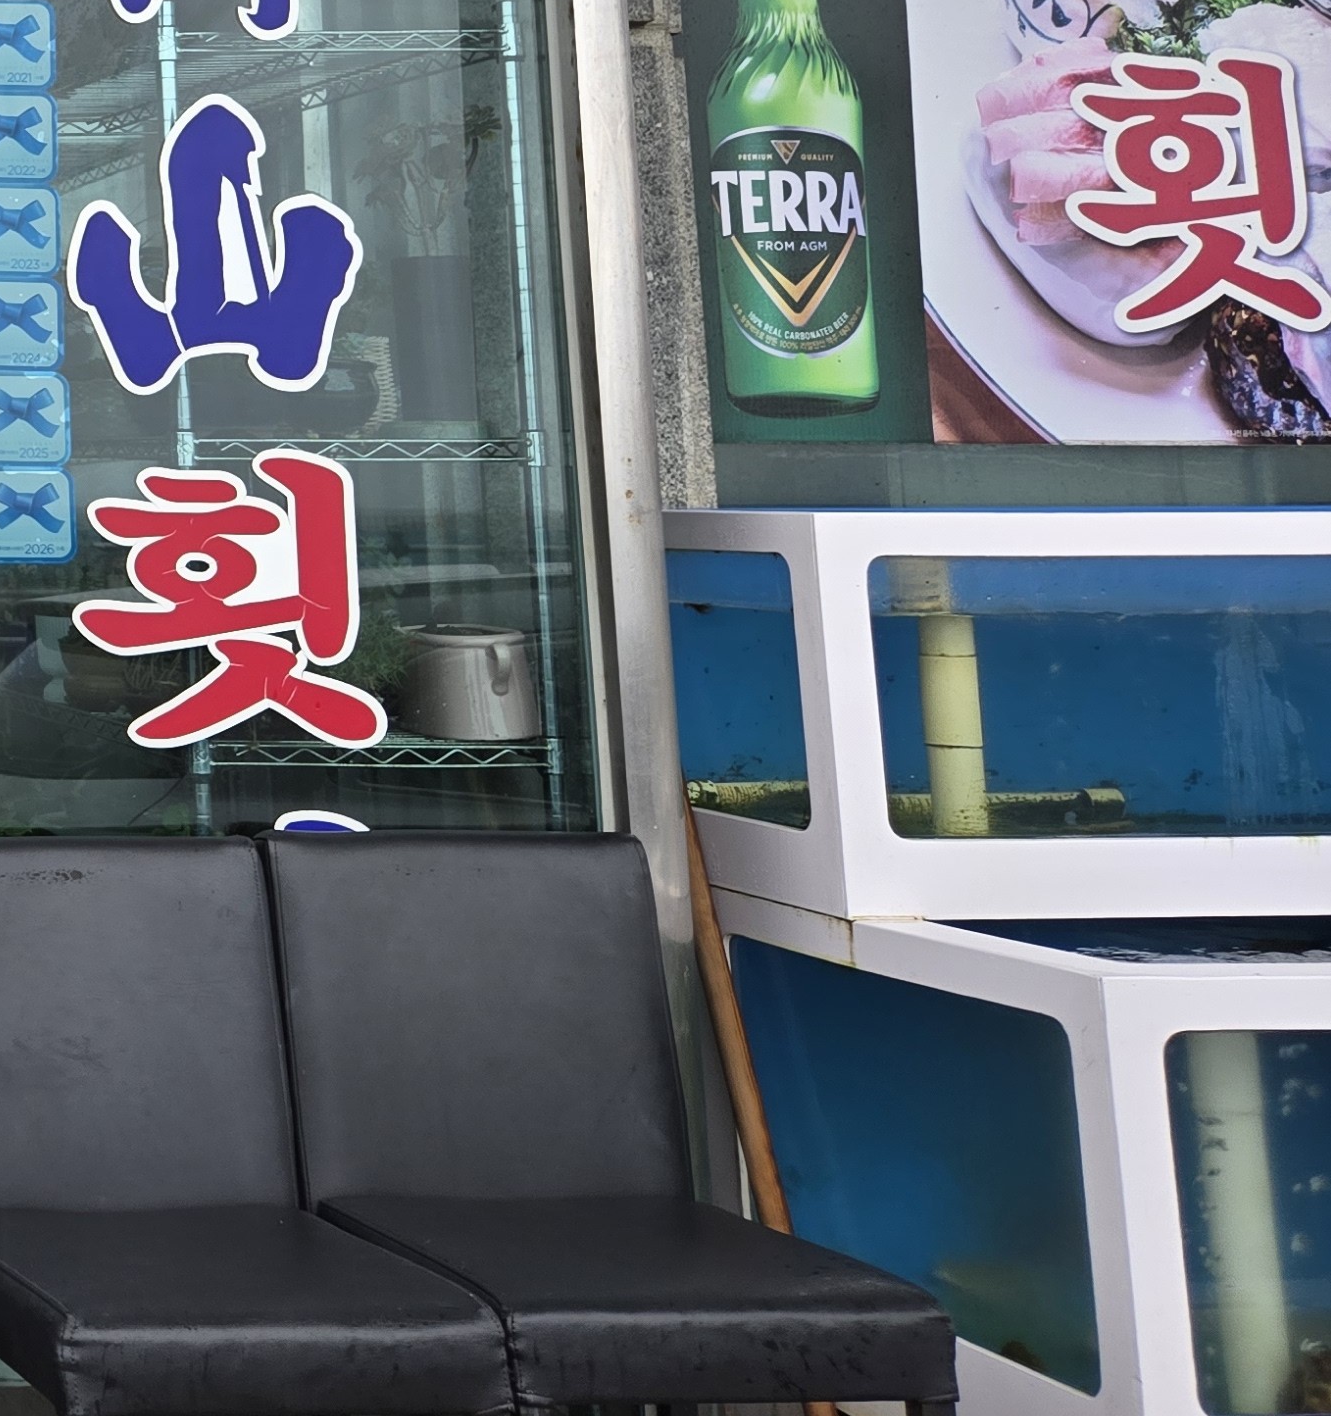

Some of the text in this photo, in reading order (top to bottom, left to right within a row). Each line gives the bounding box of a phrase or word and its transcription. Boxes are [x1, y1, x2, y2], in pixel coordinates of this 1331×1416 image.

[7, 72, 33, 83] 2021
[737, 153, 834, 161] PREMIUM QUALITY
[7, 164, 36, 176] 2022
[710, 169, 867, 237] TERRA
[756, 240, 828, 252] FROM AGM
[10, 258, 41, 270] 2023
[747, 310, 764, 329] 100%
[762, 322, 783, 338] REAL
[784, 324, 835, 341] CARBONATED
[833, 311, 850, 330] BEER
[779, 339, 799, 350] 100%
[12, 352, 41, 364] 2024
[19, 447, 49, 459] 2025
[24, 543, 55, 555] 2026
